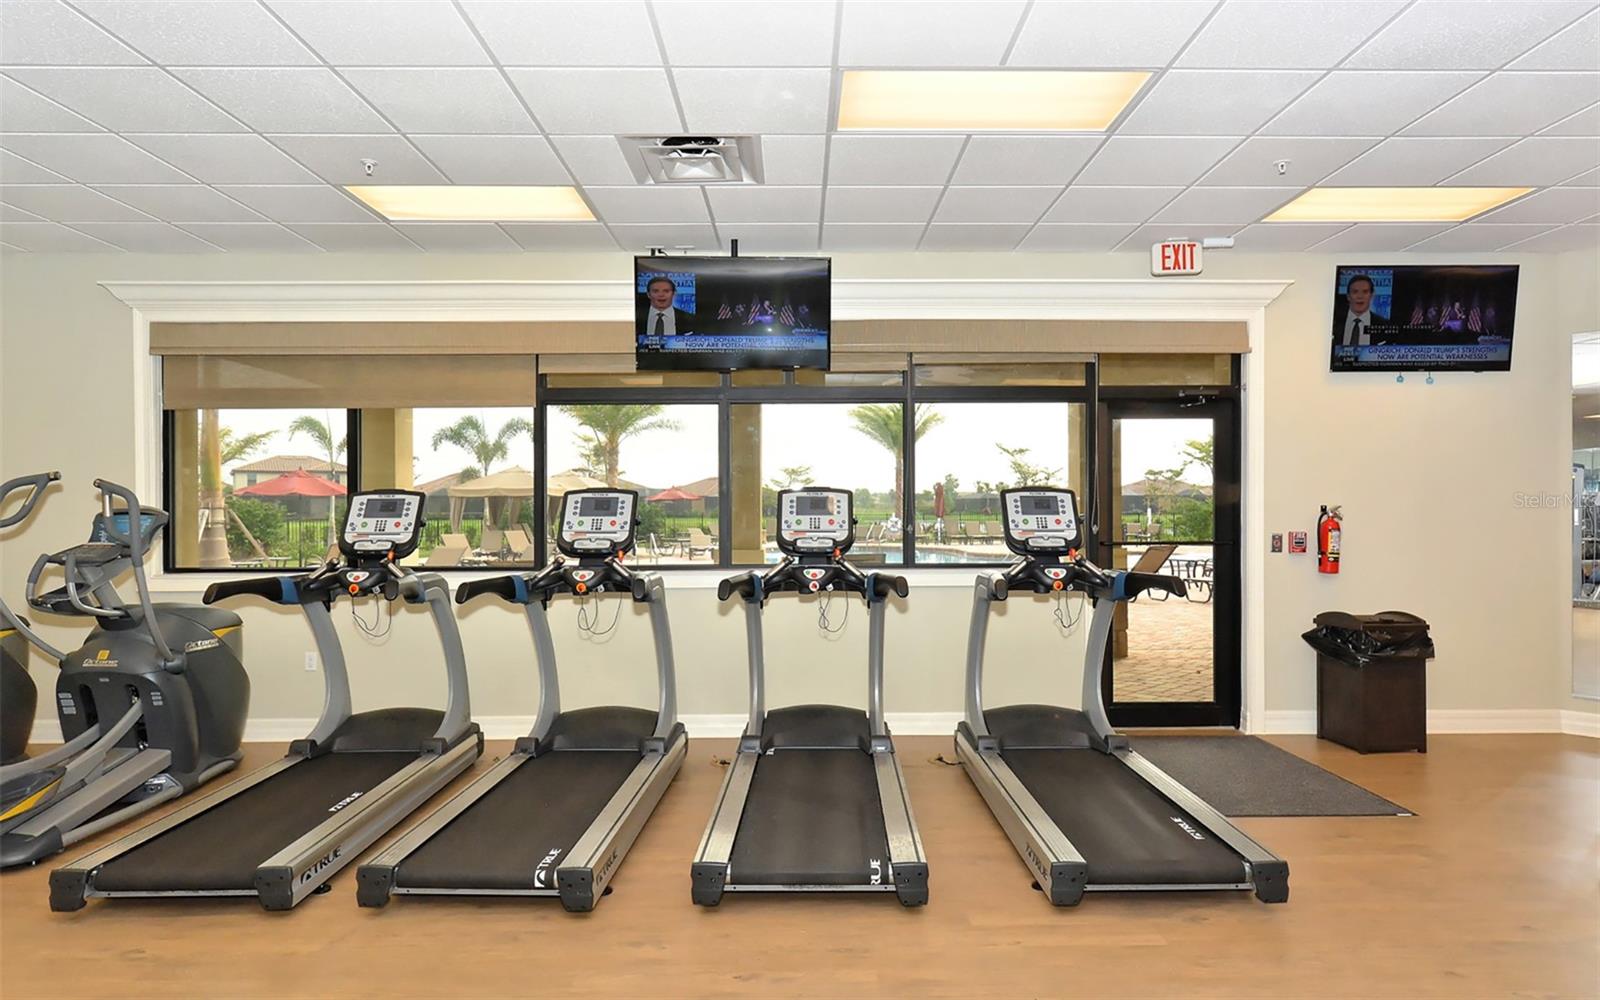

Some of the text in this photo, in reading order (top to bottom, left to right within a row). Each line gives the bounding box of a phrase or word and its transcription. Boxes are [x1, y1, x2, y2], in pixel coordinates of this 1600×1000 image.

[1161, 243, 1197, 270] EXIT
[1404, 346, 1435, 354] DONALD
[1461, 346, 1498, 354] STRENGTHS
[312, 845, 343, 875] TRUE
[536, 847, 562, 870] TRUE
